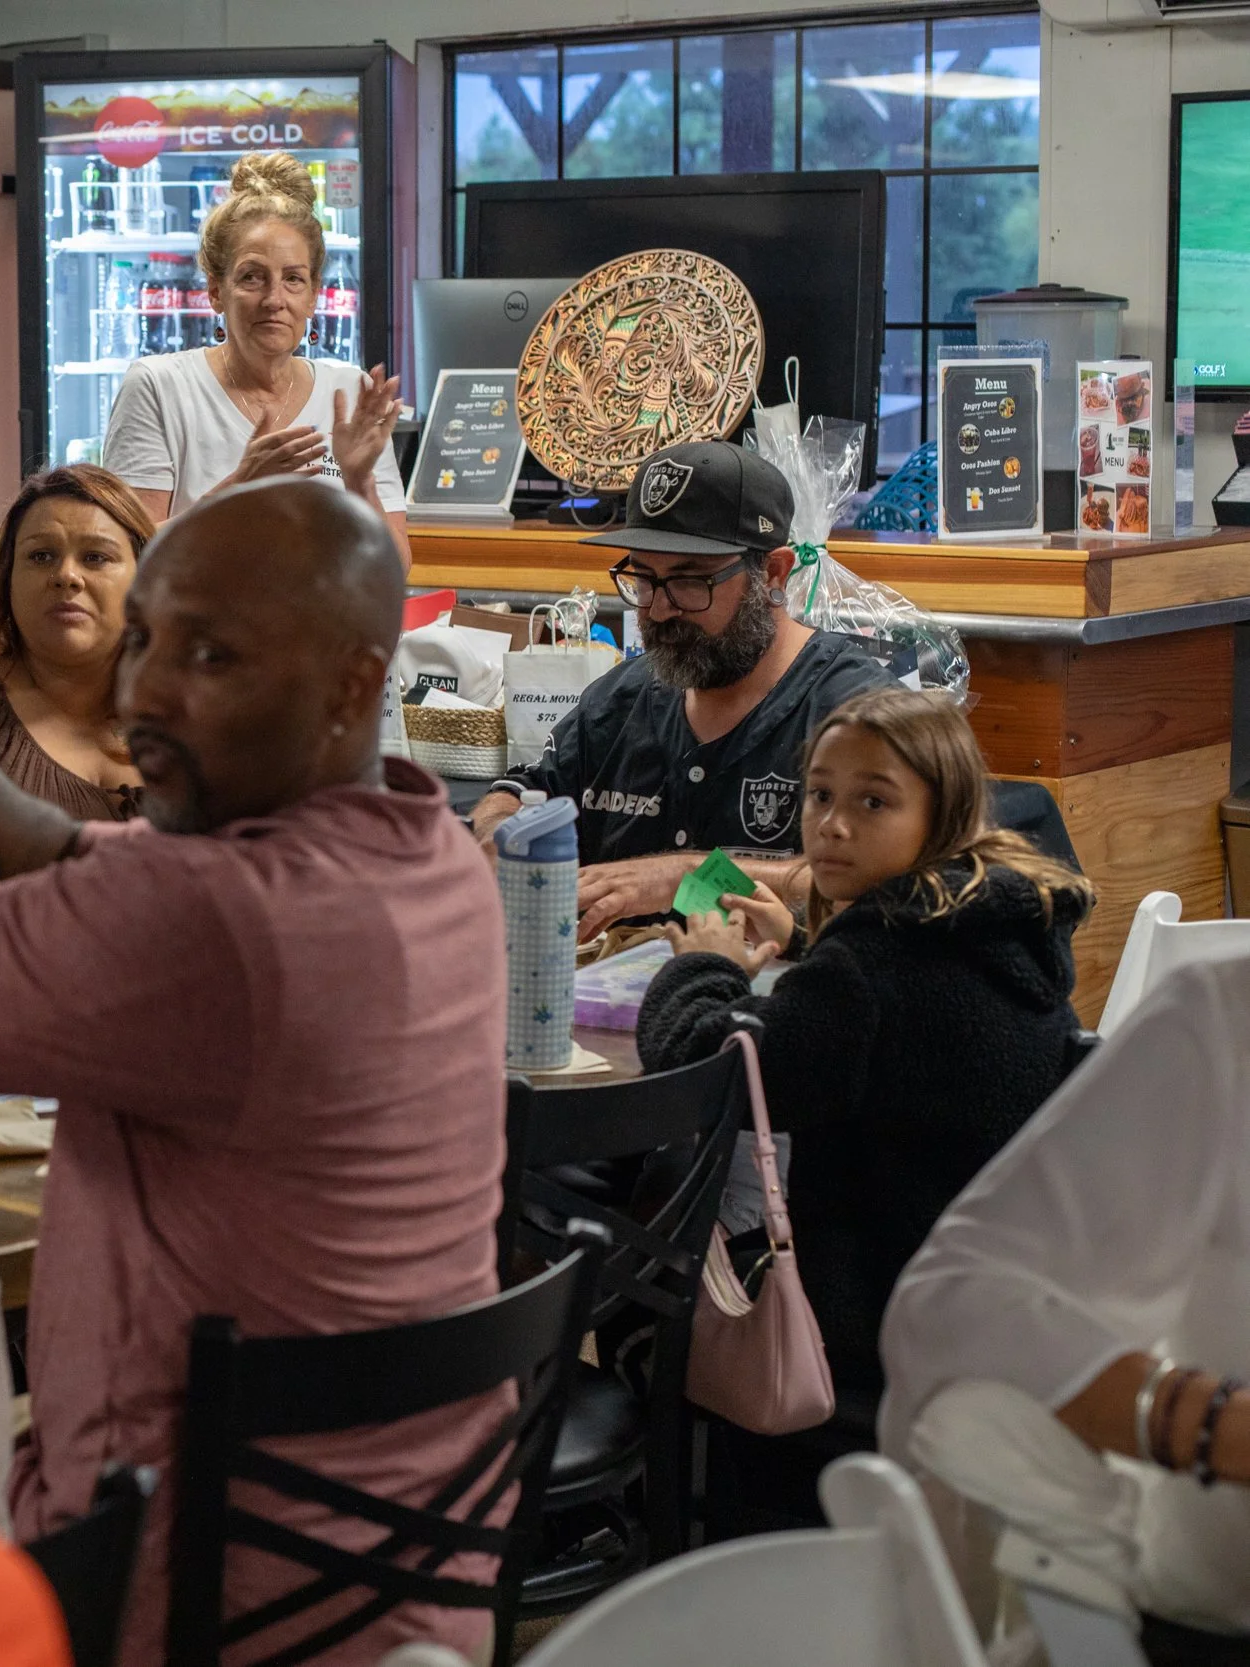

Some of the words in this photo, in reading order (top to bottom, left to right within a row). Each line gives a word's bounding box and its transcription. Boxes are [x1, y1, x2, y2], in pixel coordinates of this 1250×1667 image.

[180, 126, 223, 145] ICE
[230, 124, 303, 143] COLD
[507, 303, 525, 311] DELL
[1199, 365, 1221, 374] GOLF
[471, 383, 504, 394] Menu
[975, 378, 1007, 390] Menu
[963, 402, 981, 411] Angry
[982, 400, 997, 409] Osos
[984, 429, 1000, 437] Cuba
[961, 462, 976, 470] Osos
[977, 459, 1000, 468] Fashion
[1104, 457, 1125, 467] MENU
[650, 466, 684, 476] RAIDERS
[419, 675, 456, 690] CLEAN
[513, 694, 547, 703] REGAL
[537, 713, 557, 722] $75
[750, 783, 795, 792] RAIDERS
